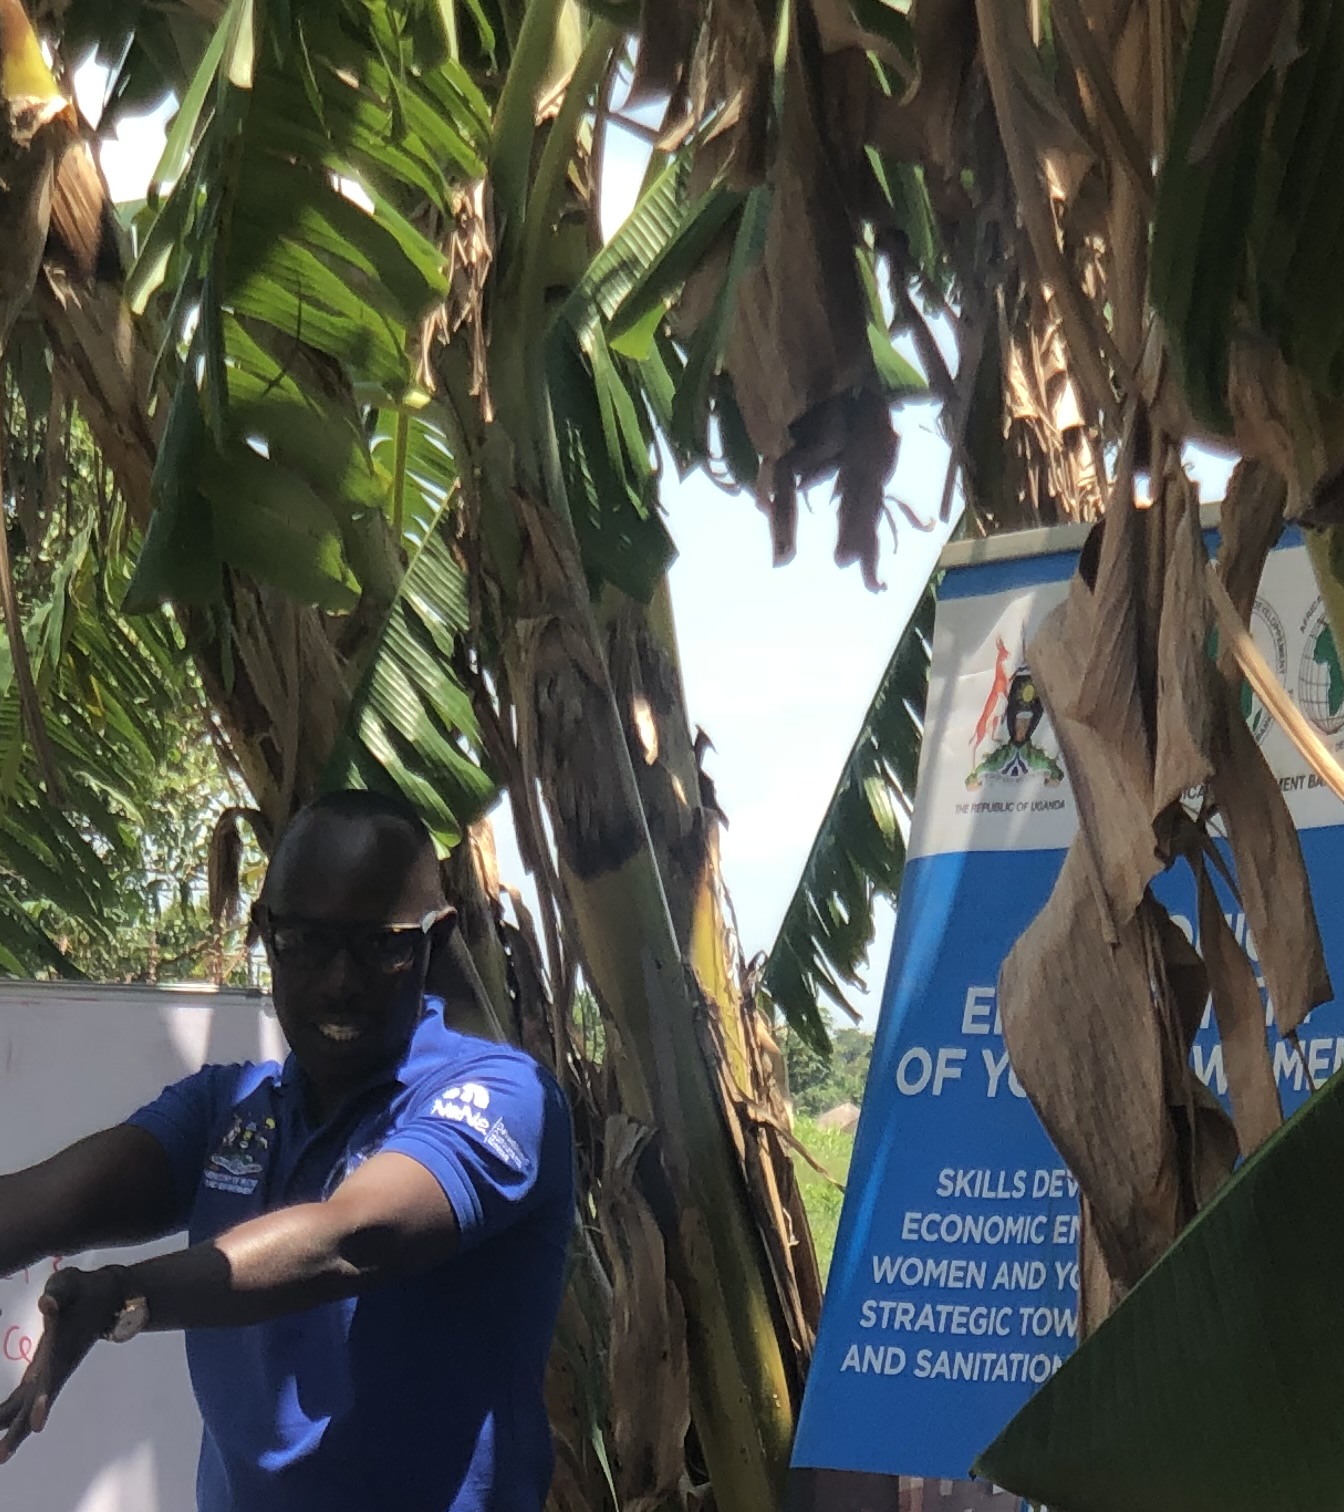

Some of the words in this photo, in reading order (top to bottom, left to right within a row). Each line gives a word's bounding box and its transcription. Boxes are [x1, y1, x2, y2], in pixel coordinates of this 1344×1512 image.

[971, 801, 1015, 814] REPUBLIC
[1017, 802, 1029, 812] OF
[1031, 800, 1065, 812] UGANDA
[896, 1047, 967, 1096] OF
[936, 1168, 1027, 1199] SKILLS
[901, 1211, 1047, 1244] ECONOMIC
[872, 1255, 987, 1289] WOMEN
[991, 1261, 1047, 1291] AND
[859, 1300, 1013, 1336] STRATEGIC
[840, 1345, 906, 1375] AND
